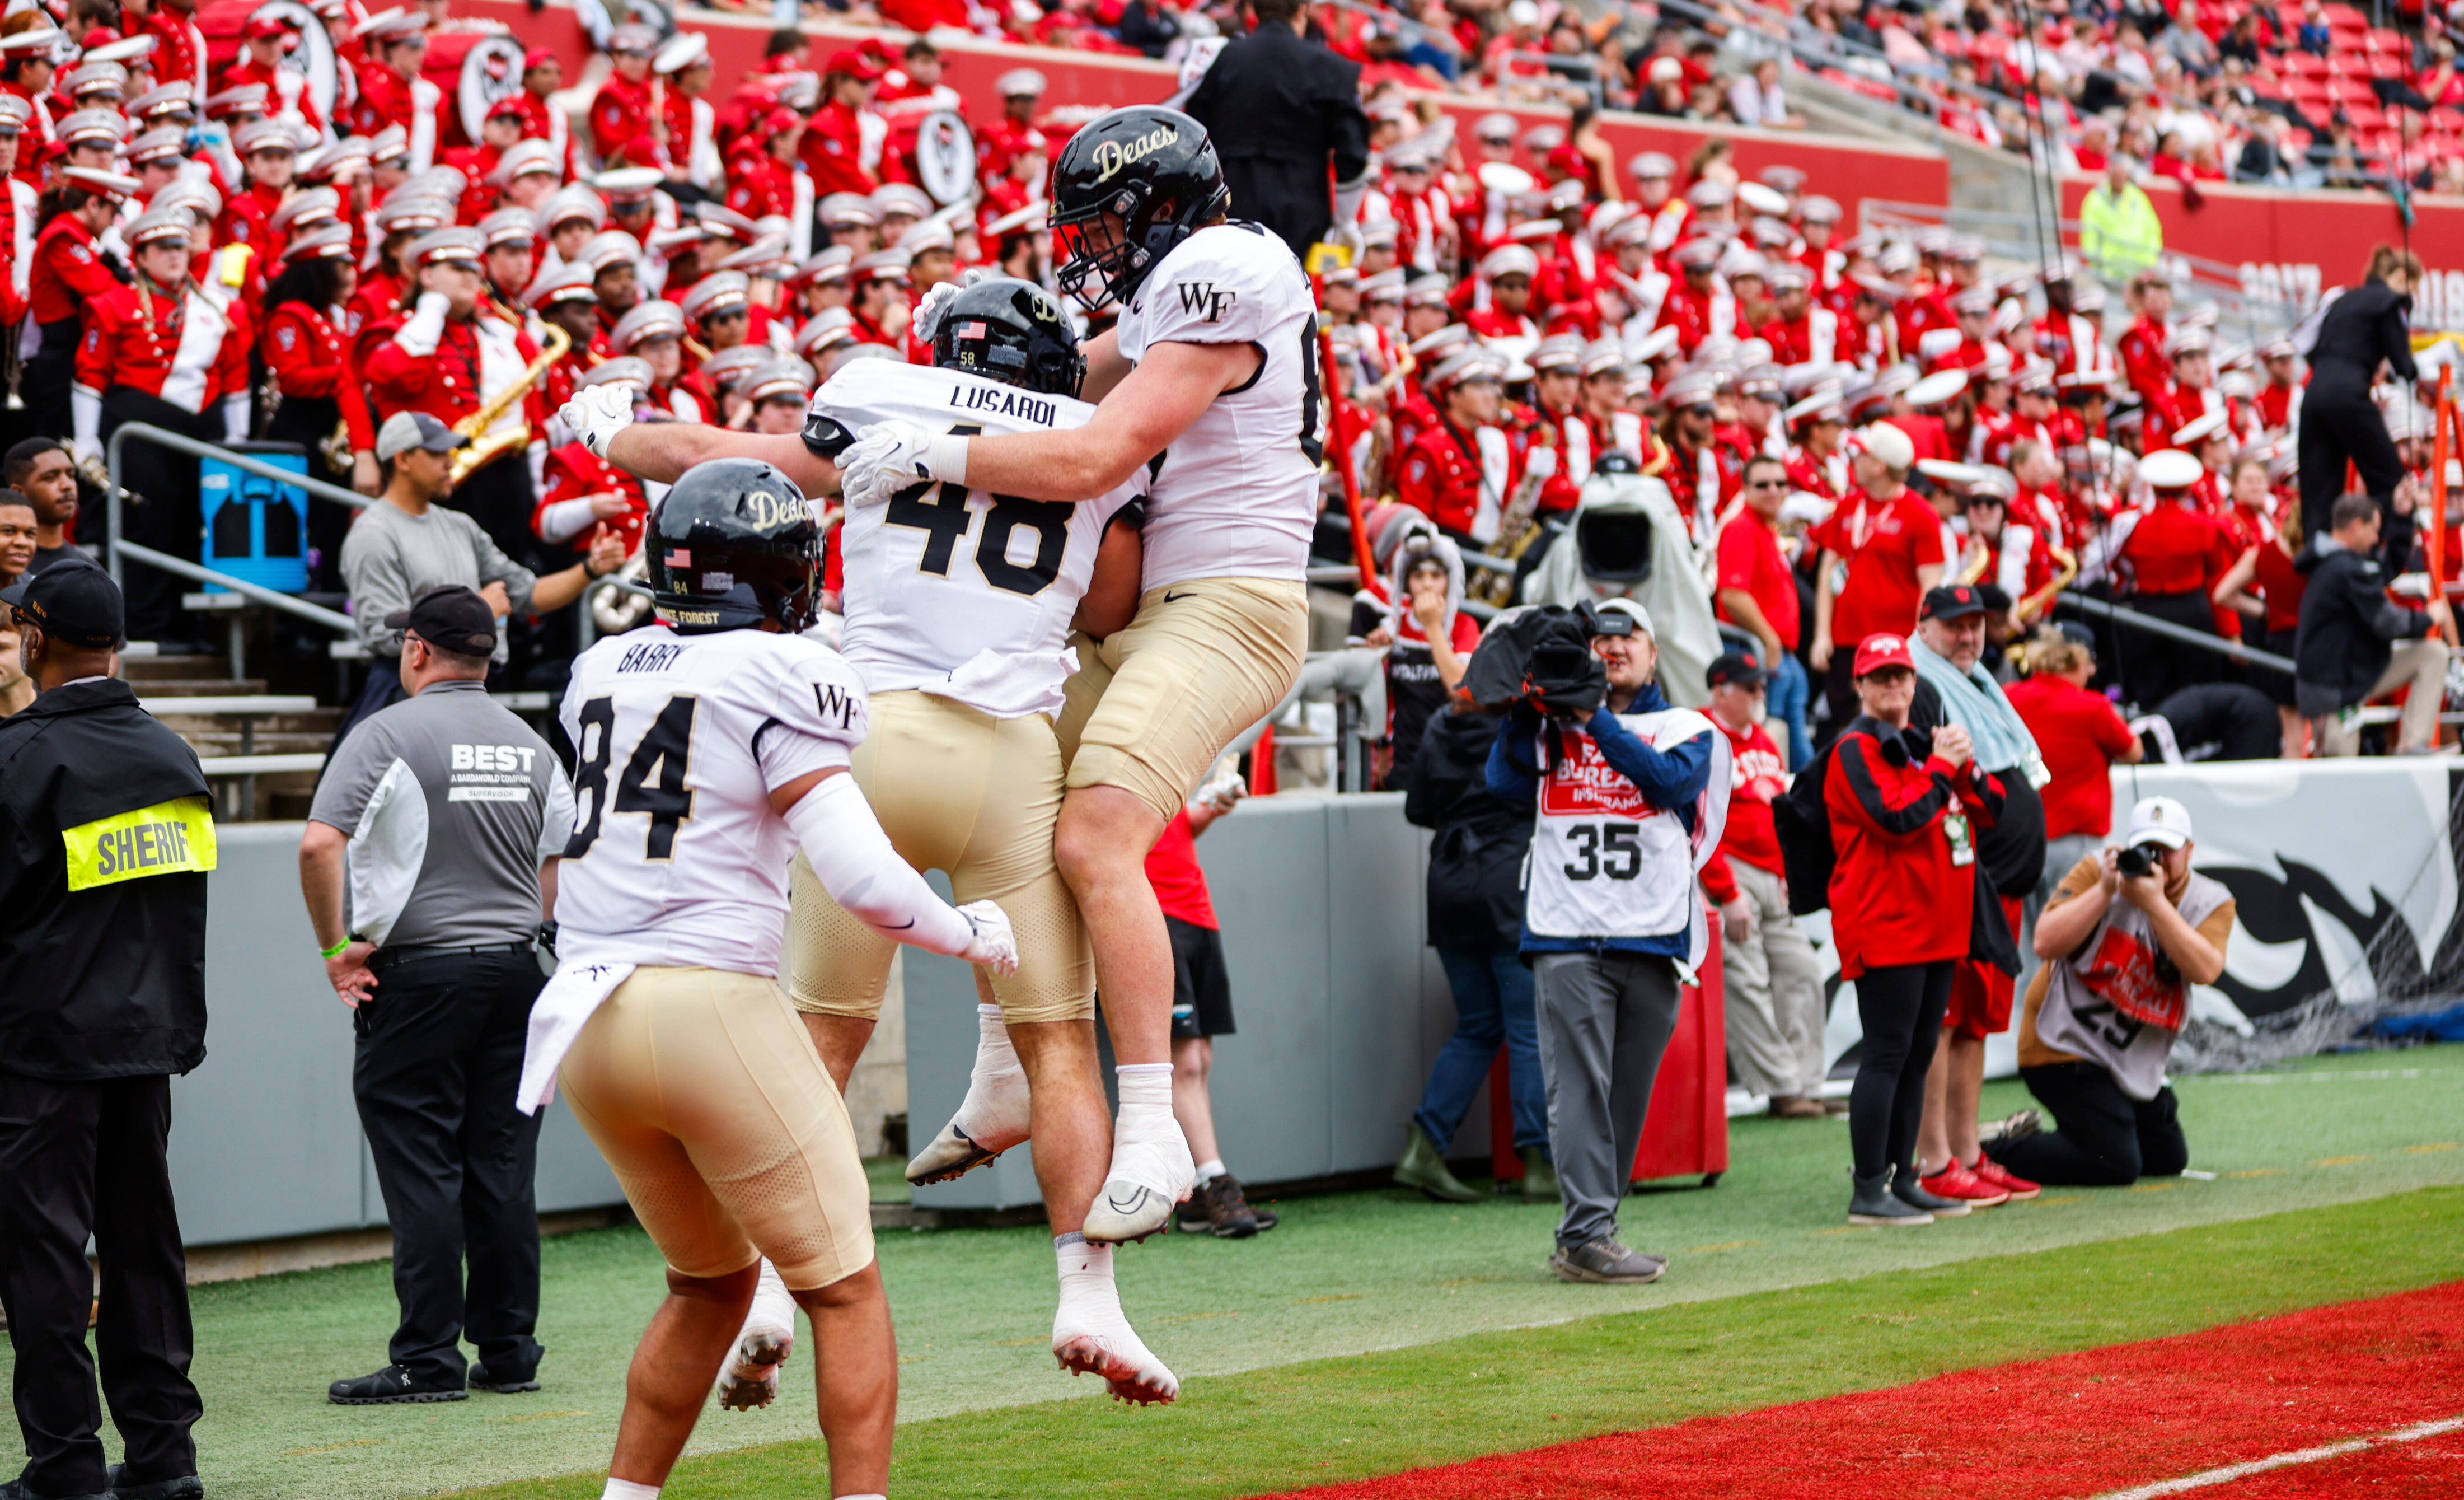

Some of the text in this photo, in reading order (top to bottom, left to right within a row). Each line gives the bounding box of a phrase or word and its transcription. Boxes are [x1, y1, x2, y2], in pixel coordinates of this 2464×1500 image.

[1093, 125, 1179, 183] Deacs
[1177, 282, 1236, 323] WF
[961, 352, 975, 366] 58
[950, 386, 1057, 427] LUSARDI
[881, 421, 1078, 599] 48
[673, 580, 688, 595] 84
[679, 611, 720, 624] FOREST
[617, 643, 693, 673] BARRY
[811, 682, 863, 731] WF
[452, 744, 536, 772] BEST
[1581, 742, 1605, 764] FA
[451, 774, 457, 783] A
[500, 774, 531, 783] COMPANY
[560, 693, 699, 863] 84
[1557, 757, 1636, 790] BUREA
[1564, 824, 1643, 881] 35
